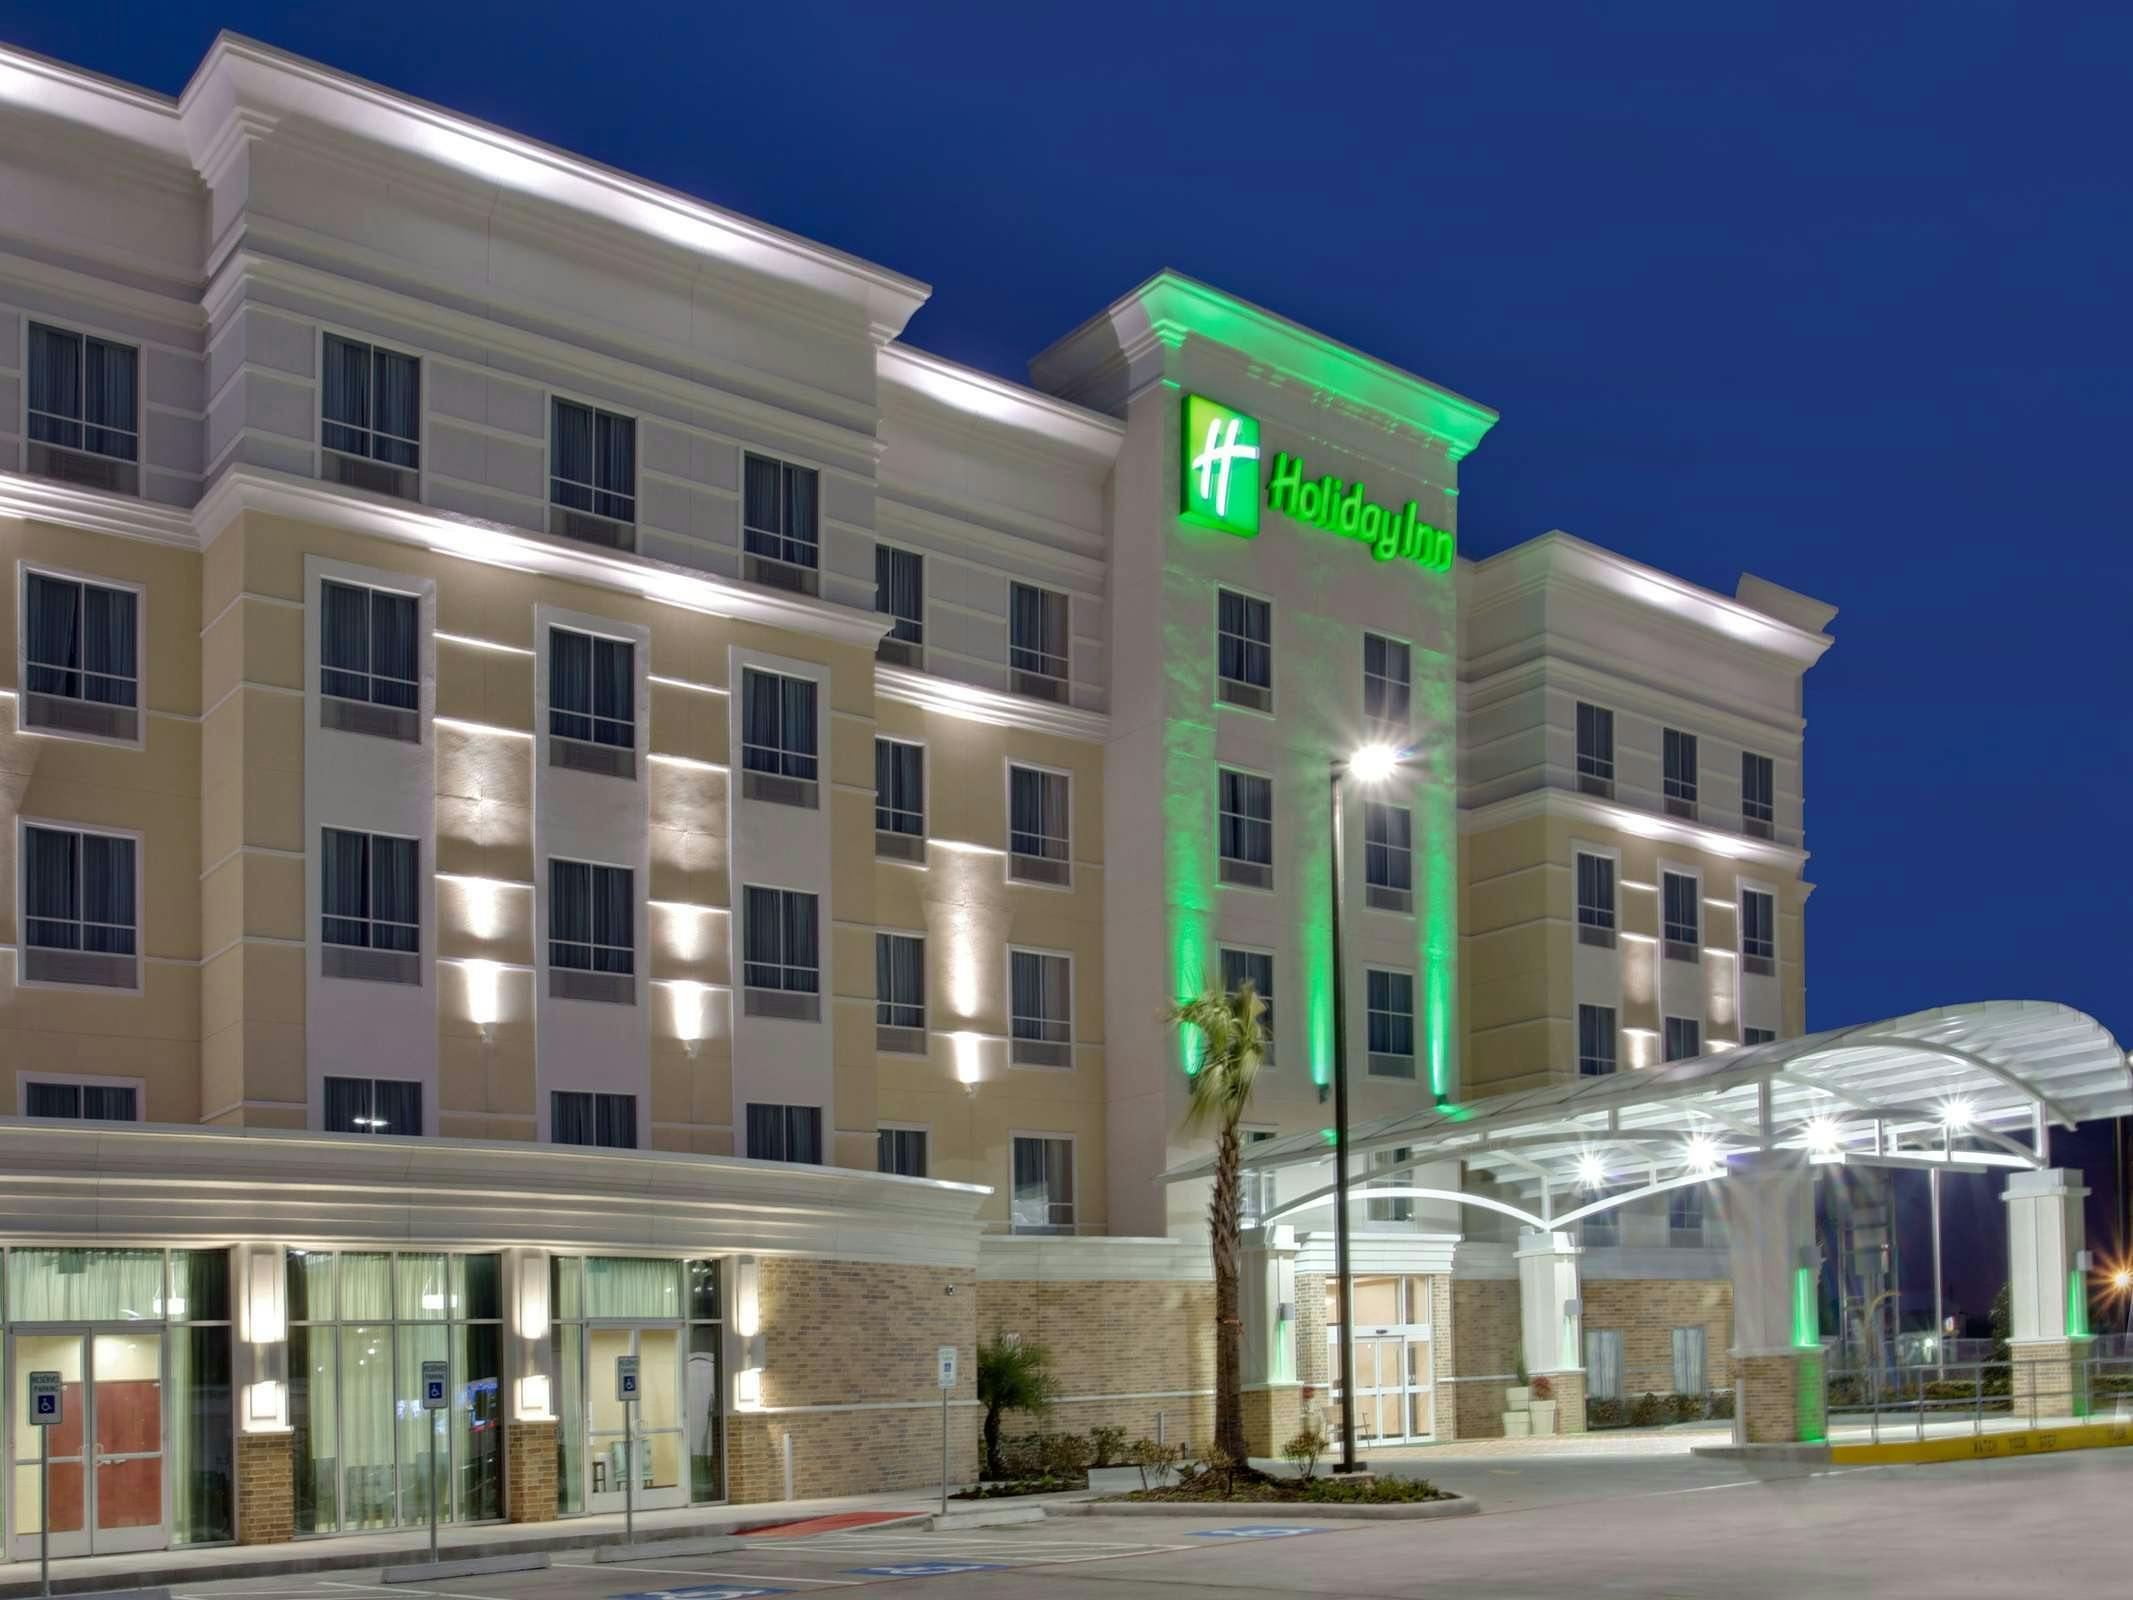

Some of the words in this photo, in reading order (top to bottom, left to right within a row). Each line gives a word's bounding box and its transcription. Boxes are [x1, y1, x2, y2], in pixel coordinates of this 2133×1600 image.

[1266, 451, 1402, 562] Holiday
[1399, 500, 1455, 573] Inn
[33, 1384, 59, 1392] PARKING
